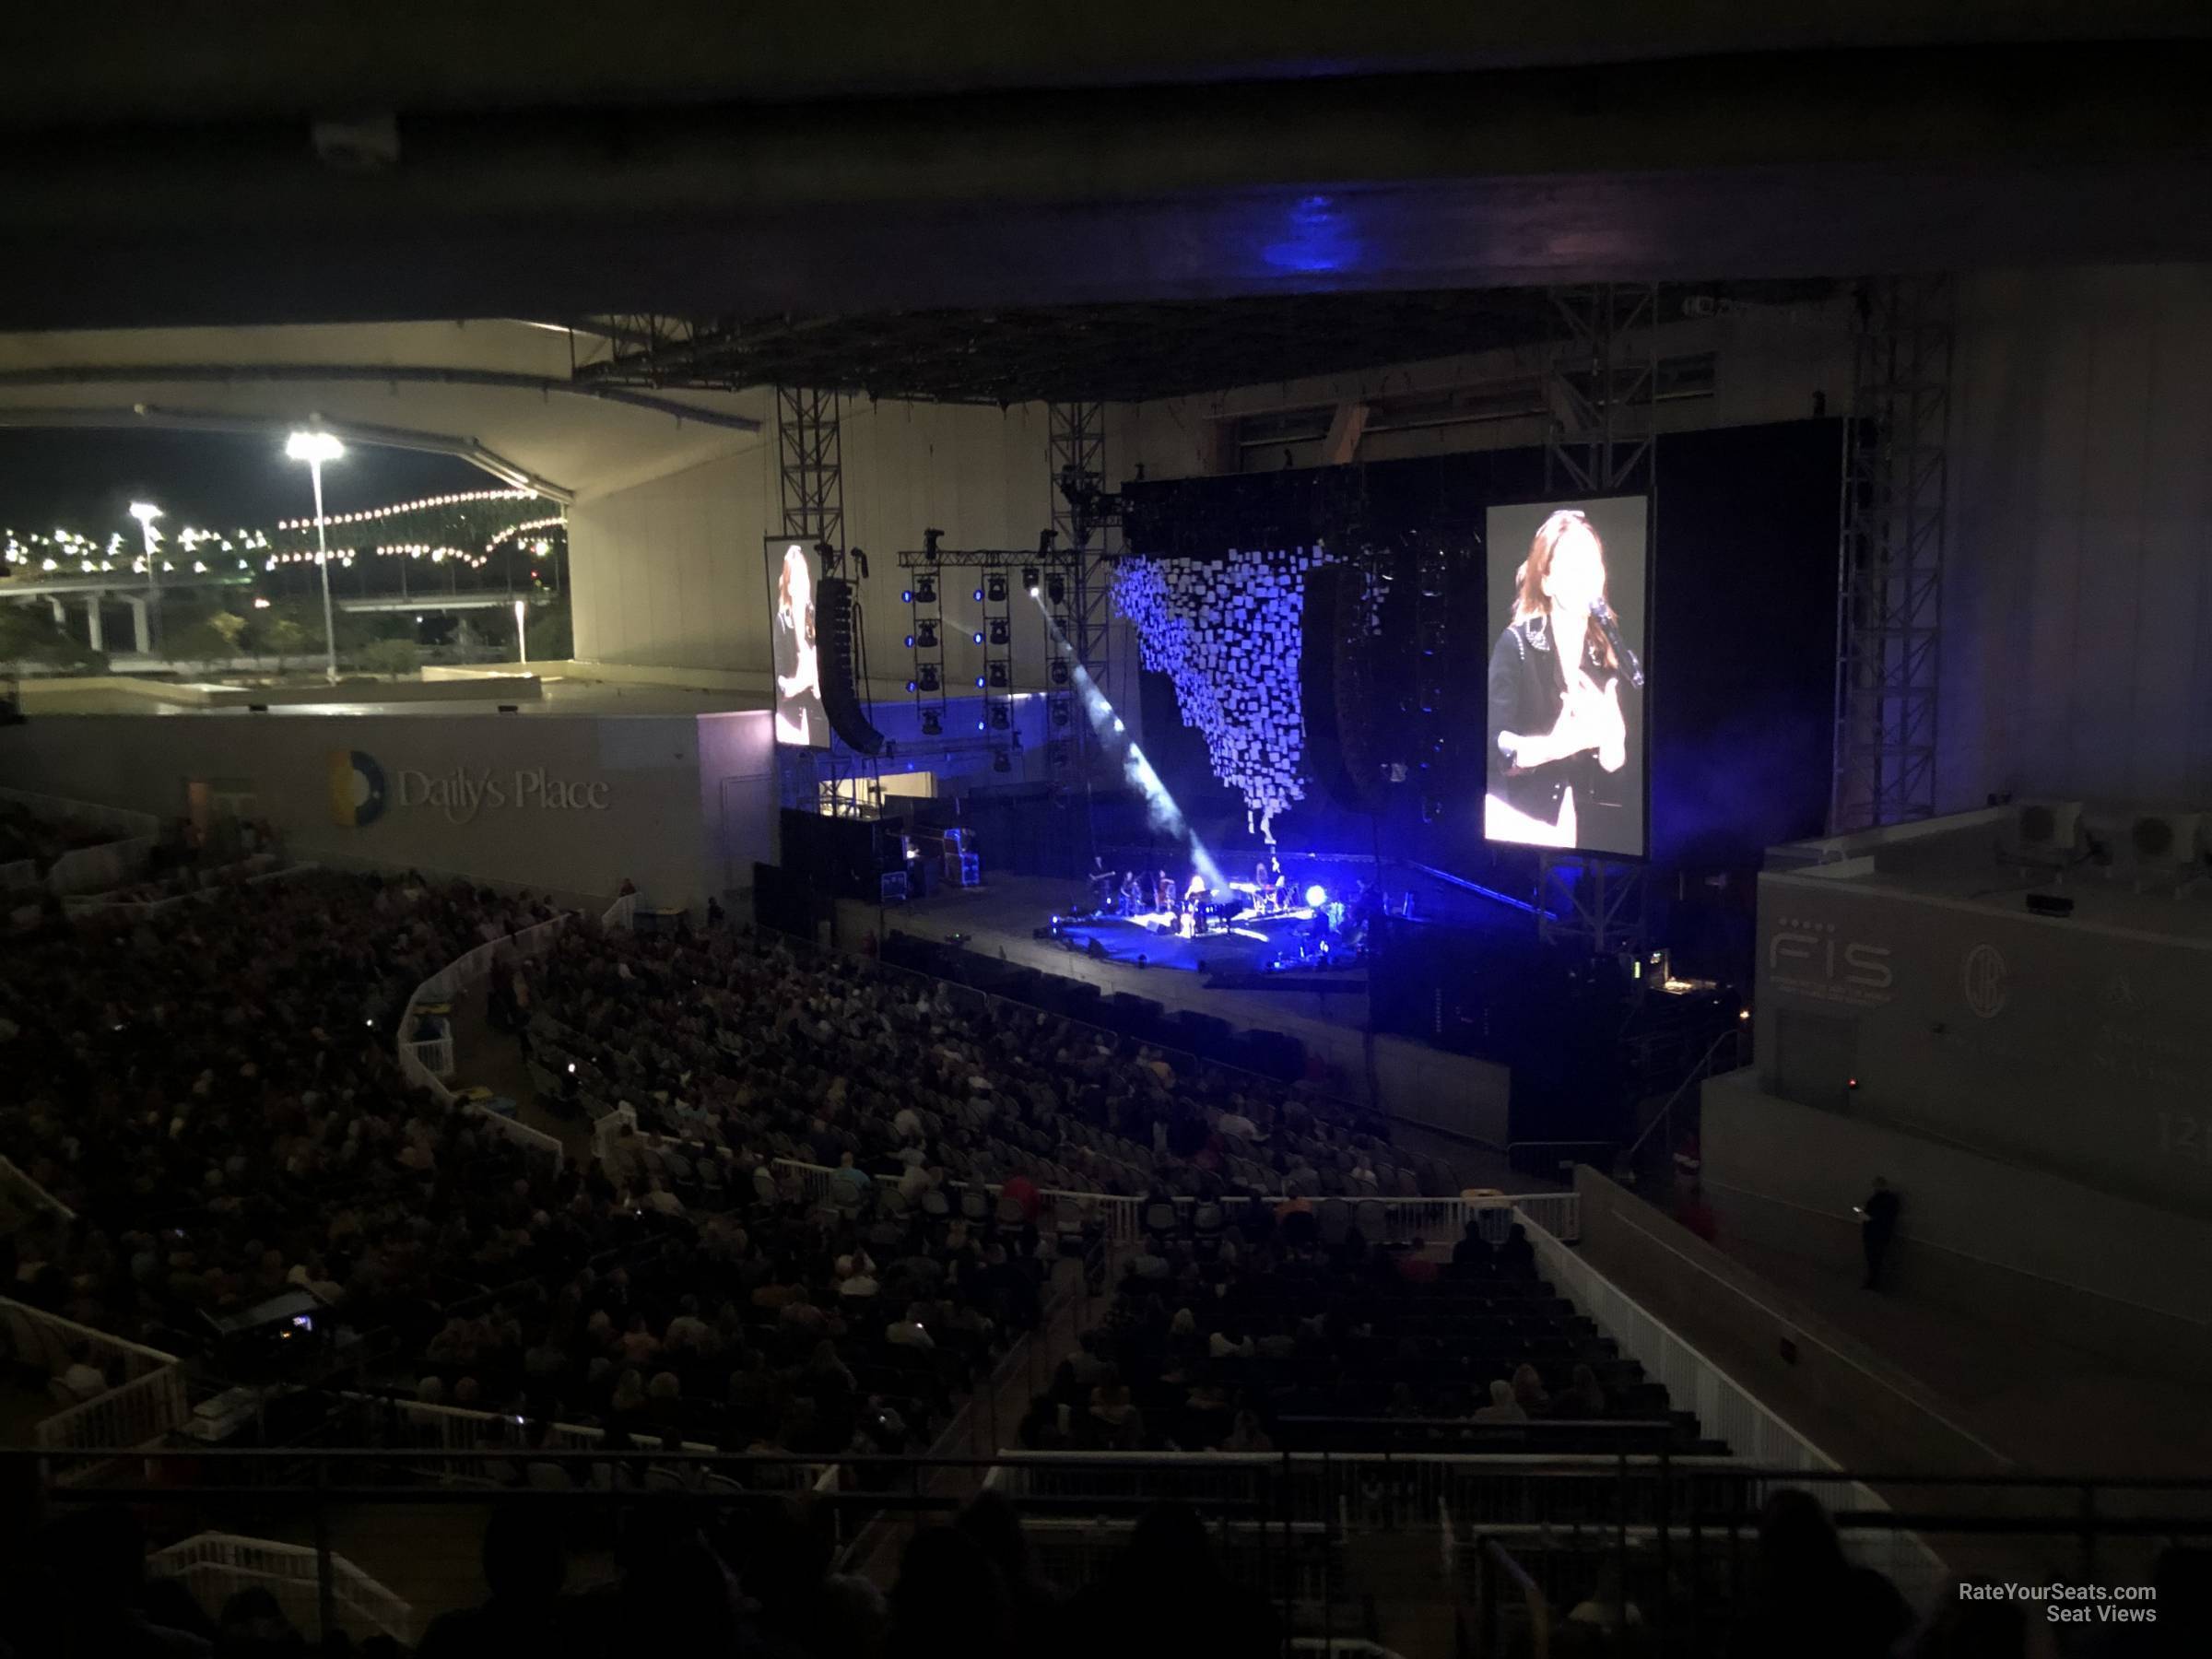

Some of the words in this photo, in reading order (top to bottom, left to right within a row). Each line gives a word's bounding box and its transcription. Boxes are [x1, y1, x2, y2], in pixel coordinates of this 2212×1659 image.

[397, 766, 508, 825] Daily's
[514, 767, 612, 810] Place
[1769, 931, 1893, 990] FIS
